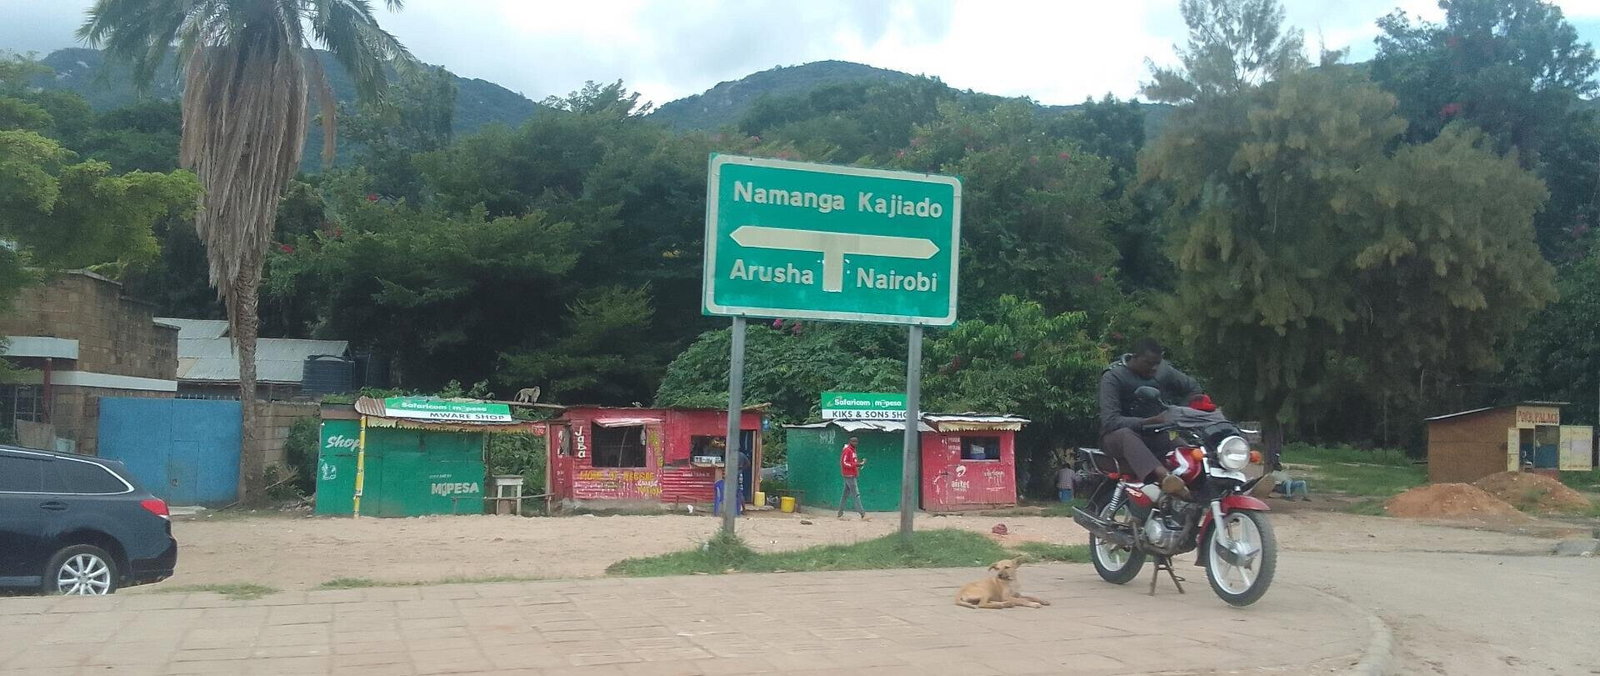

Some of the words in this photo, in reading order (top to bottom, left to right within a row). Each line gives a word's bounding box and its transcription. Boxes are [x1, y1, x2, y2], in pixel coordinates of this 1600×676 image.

[733, 180, 845, 213] Namanga
[858, 191, 943, 218] Kajiado
[729, 258, 814, 285] Arusha
[856, 267, 938, 292] Nairobi
[401, 401, 447, 410] Safaricom
[834, 398, 871, 406] Safaricom
[832, 410, 852, 418] KIKS
[865, 411, 889, 419] SONS
[325, 434, 361, 453] Shop
